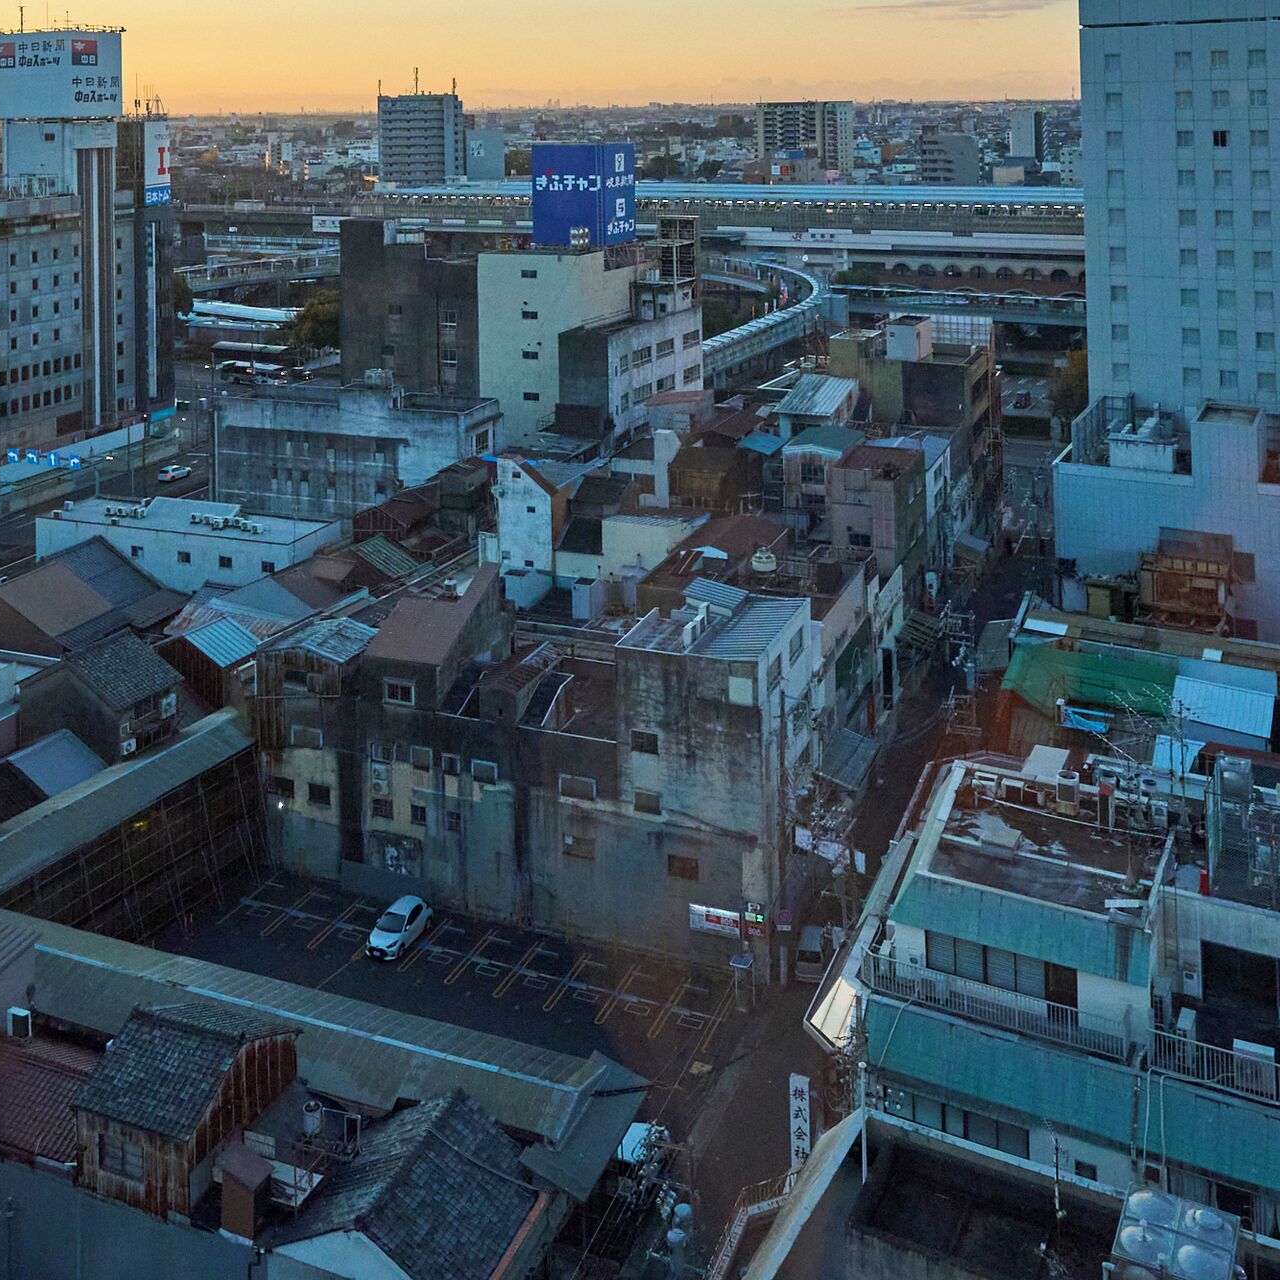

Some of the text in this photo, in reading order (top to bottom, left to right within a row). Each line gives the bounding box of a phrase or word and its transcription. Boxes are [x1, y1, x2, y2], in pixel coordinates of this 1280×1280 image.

[18, 39, 65, 53] 中日新聞
[18, 55, 61, 67] 中日スポーツ
[72, 75, 120, 89] 中日新聞
[74, 90, 117, 103] 中日スポーツ
[158, 147, 171, 175] I
[535, 170, 601, 191] ぎふチャン
[792, 1086, 809, 1161] 株式会社
